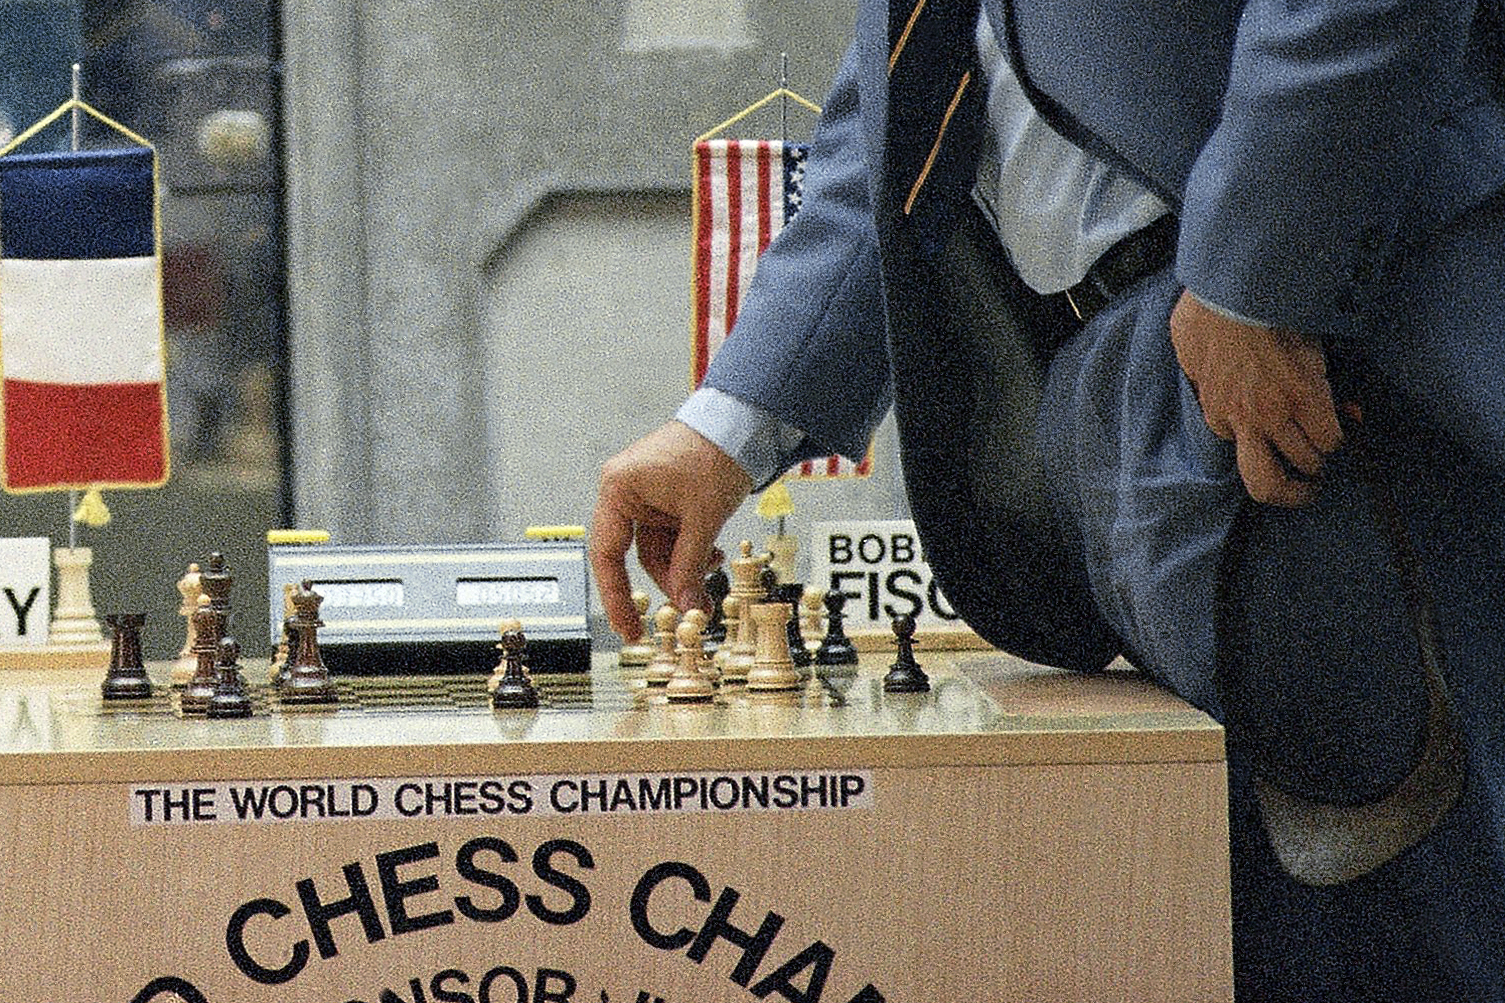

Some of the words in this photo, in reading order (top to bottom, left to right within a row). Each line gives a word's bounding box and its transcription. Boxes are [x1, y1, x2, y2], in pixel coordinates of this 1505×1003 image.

[135, 788, 217, 822] THE
[229, 784, 380, 820] WORLD
[394, 780, 534, 817] CHESS
[550, 775, 866, 814] CHAMPIONSHIP
[225, 836, 596, 985] CHESS
[629, 861, 887, 1003] CHA
